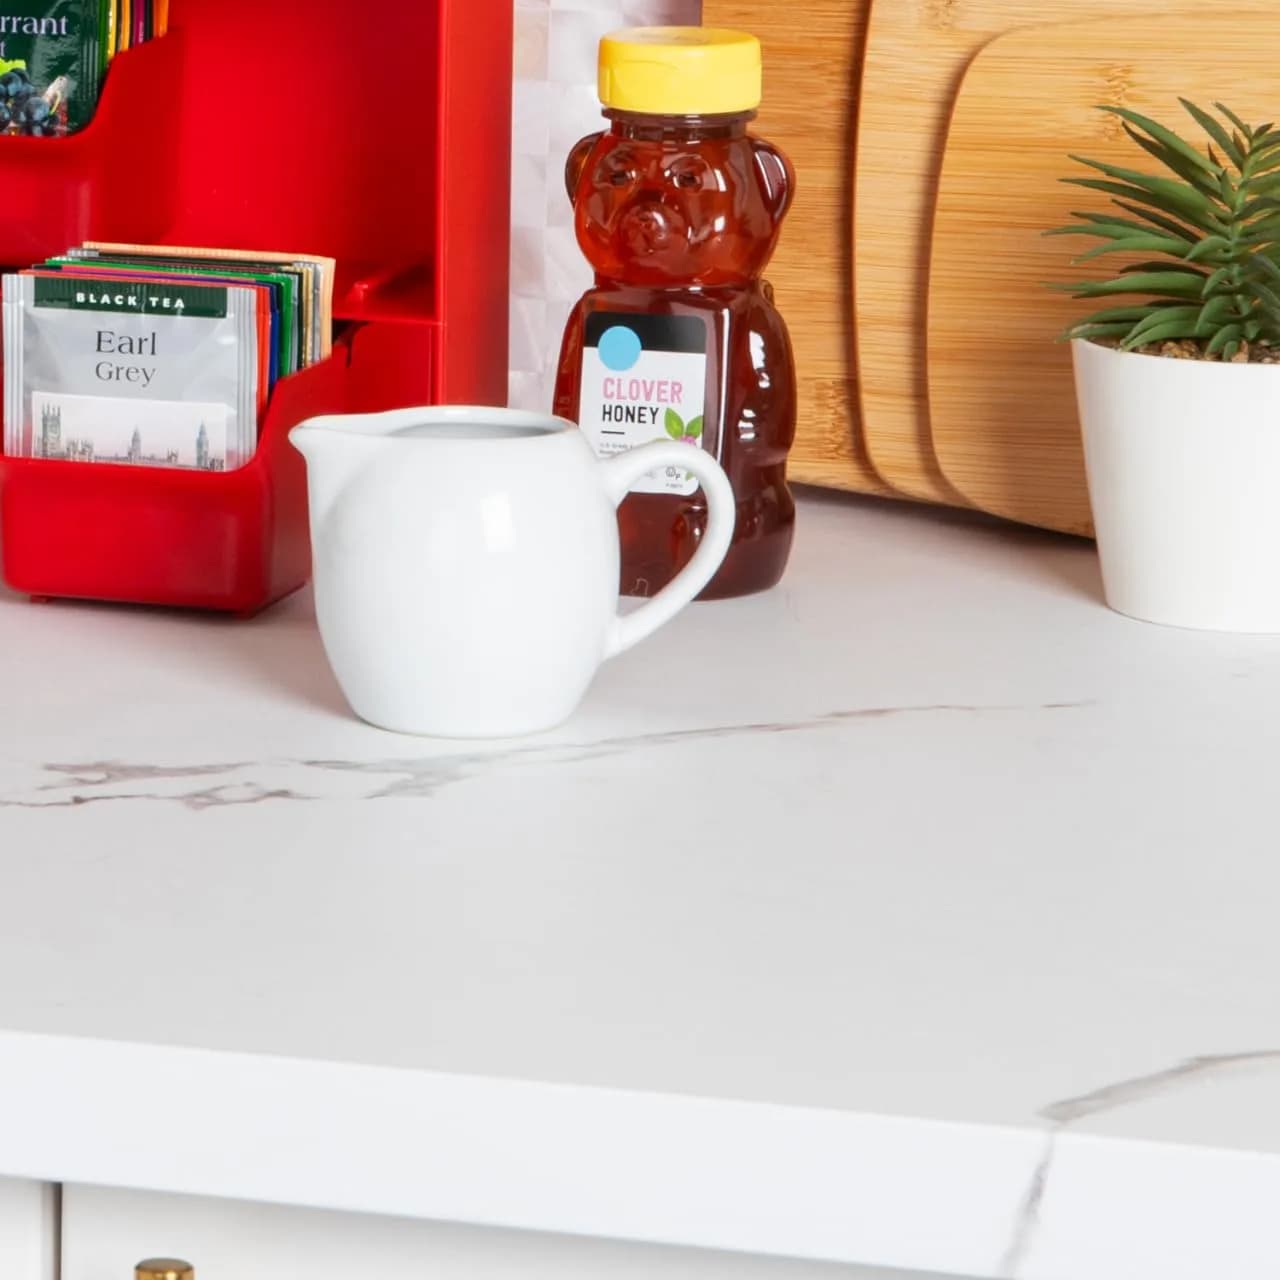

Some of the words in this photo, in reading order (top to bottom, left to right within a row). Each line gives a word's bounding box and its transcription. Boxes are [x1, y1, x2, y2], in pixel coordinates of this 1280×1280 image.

[76, 292, 137, 307] BLACK
[149, 296, 185, 308] TEA
[95, 330, 157, 357] Earl
[95, 361, 157, 388] Grey
[602, 377, 683, 404] CLOVER
[601, 404, 660, 425] HONEY
